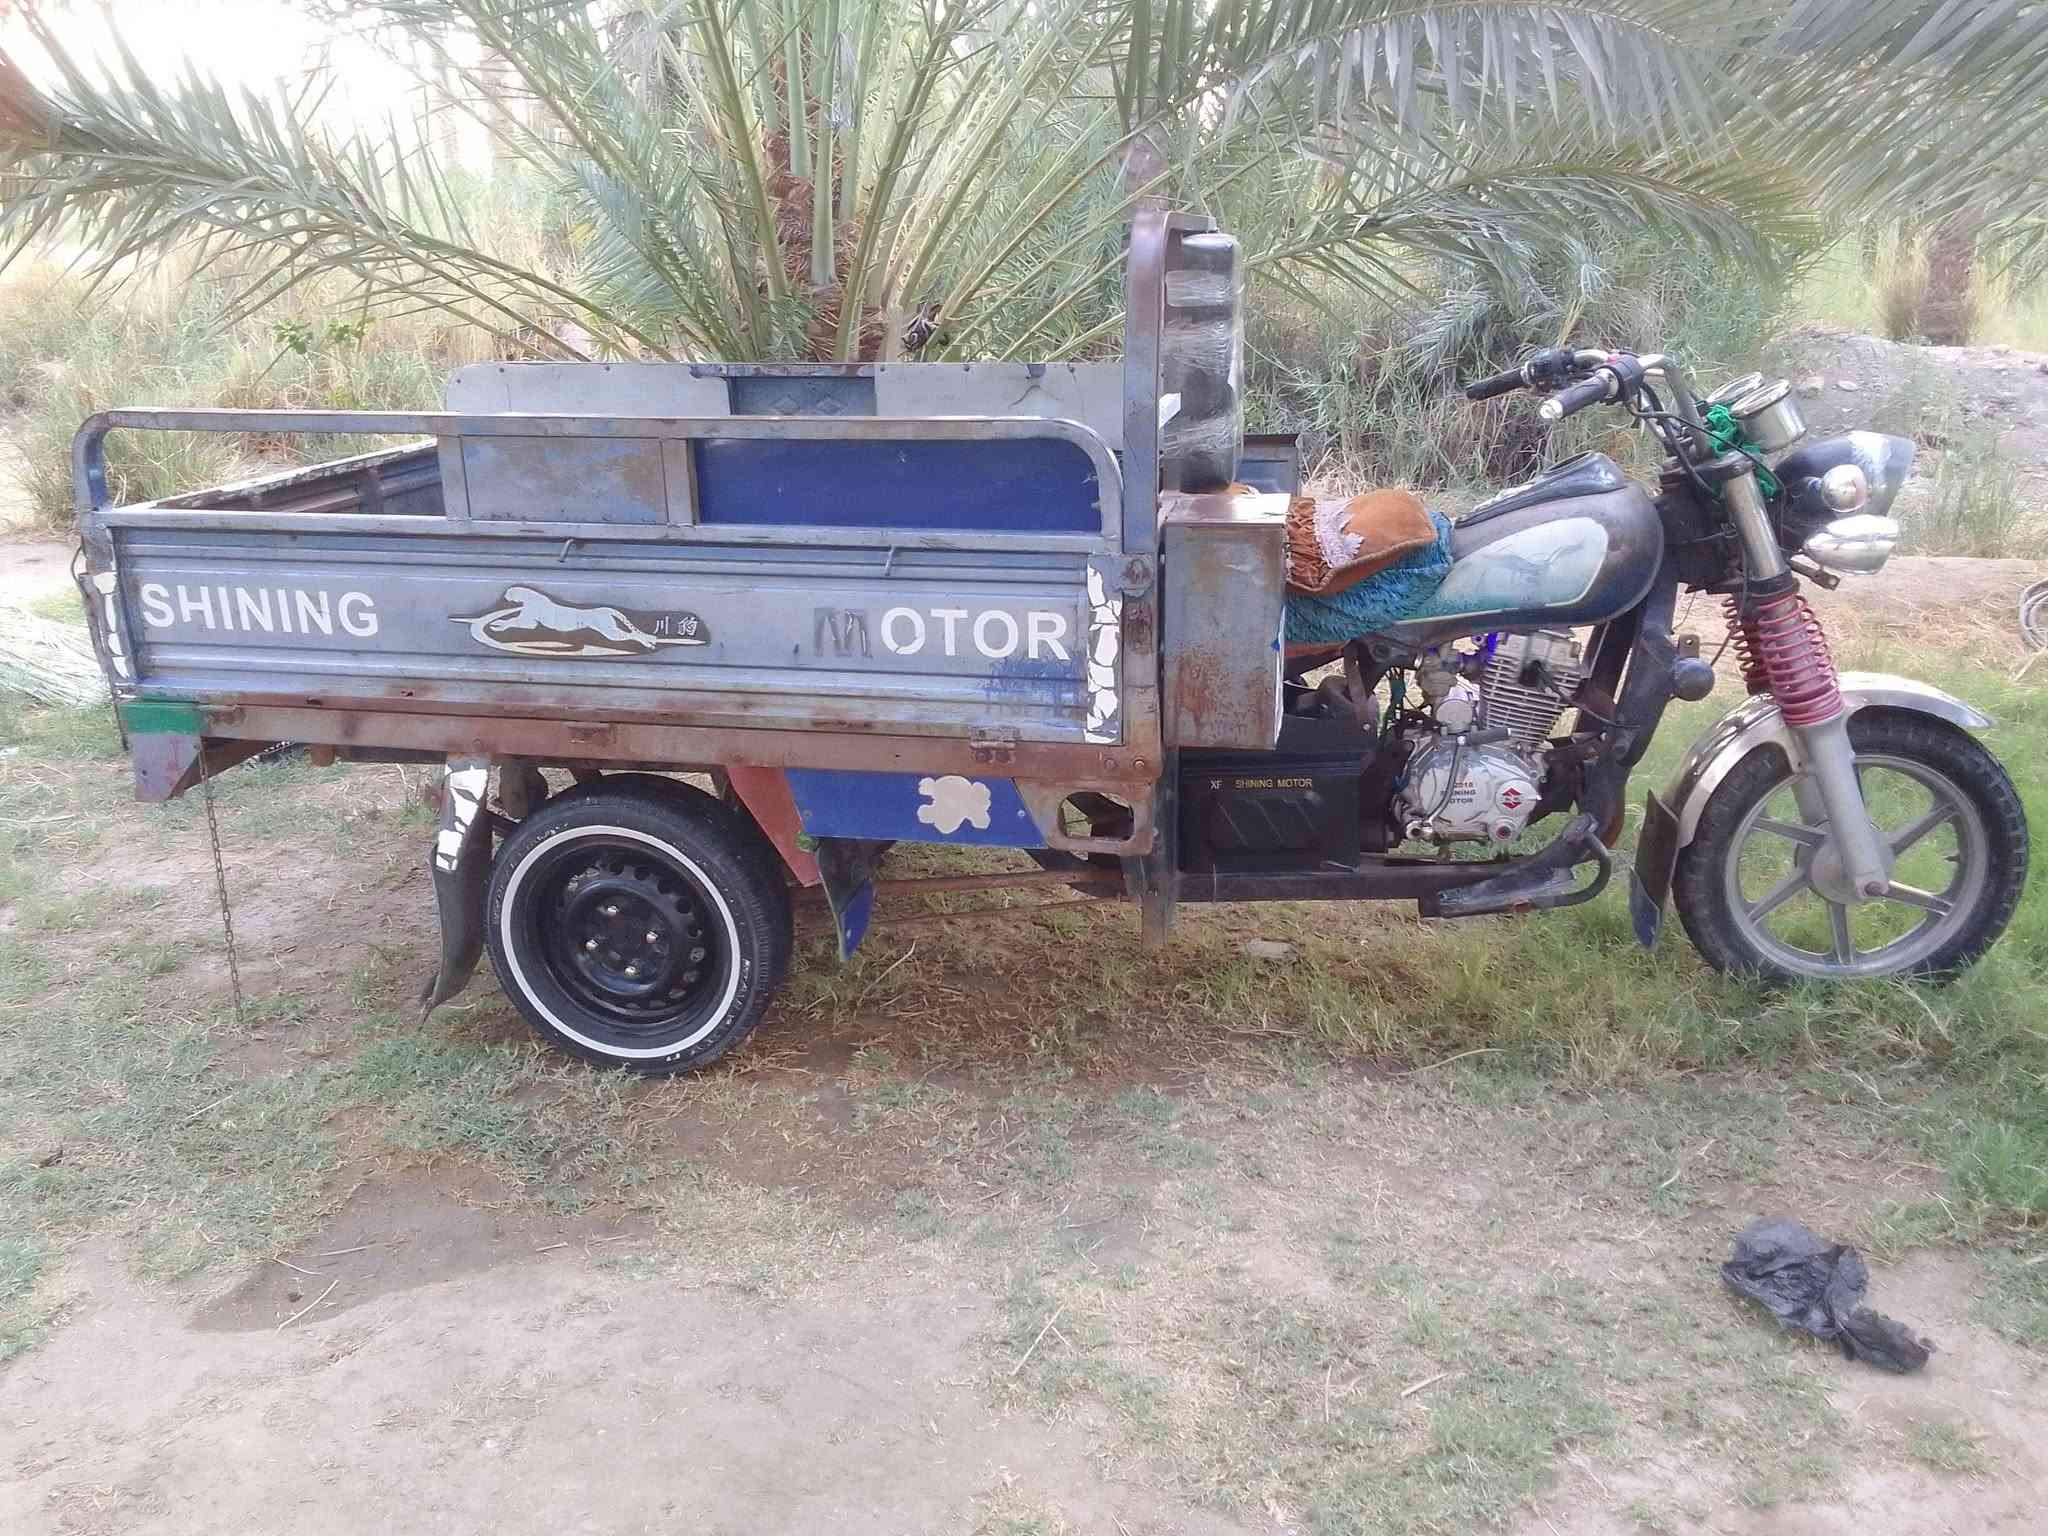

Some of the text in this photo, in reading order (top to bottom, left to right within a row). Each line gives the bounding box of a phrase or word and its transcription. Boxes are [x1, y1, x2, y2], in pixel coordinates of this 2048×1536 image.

[140, 583, 379, 637] SHINING
[1235, 779, 1273, 789] SHINING
[1277, 778, 1313, 788] MOTOR
